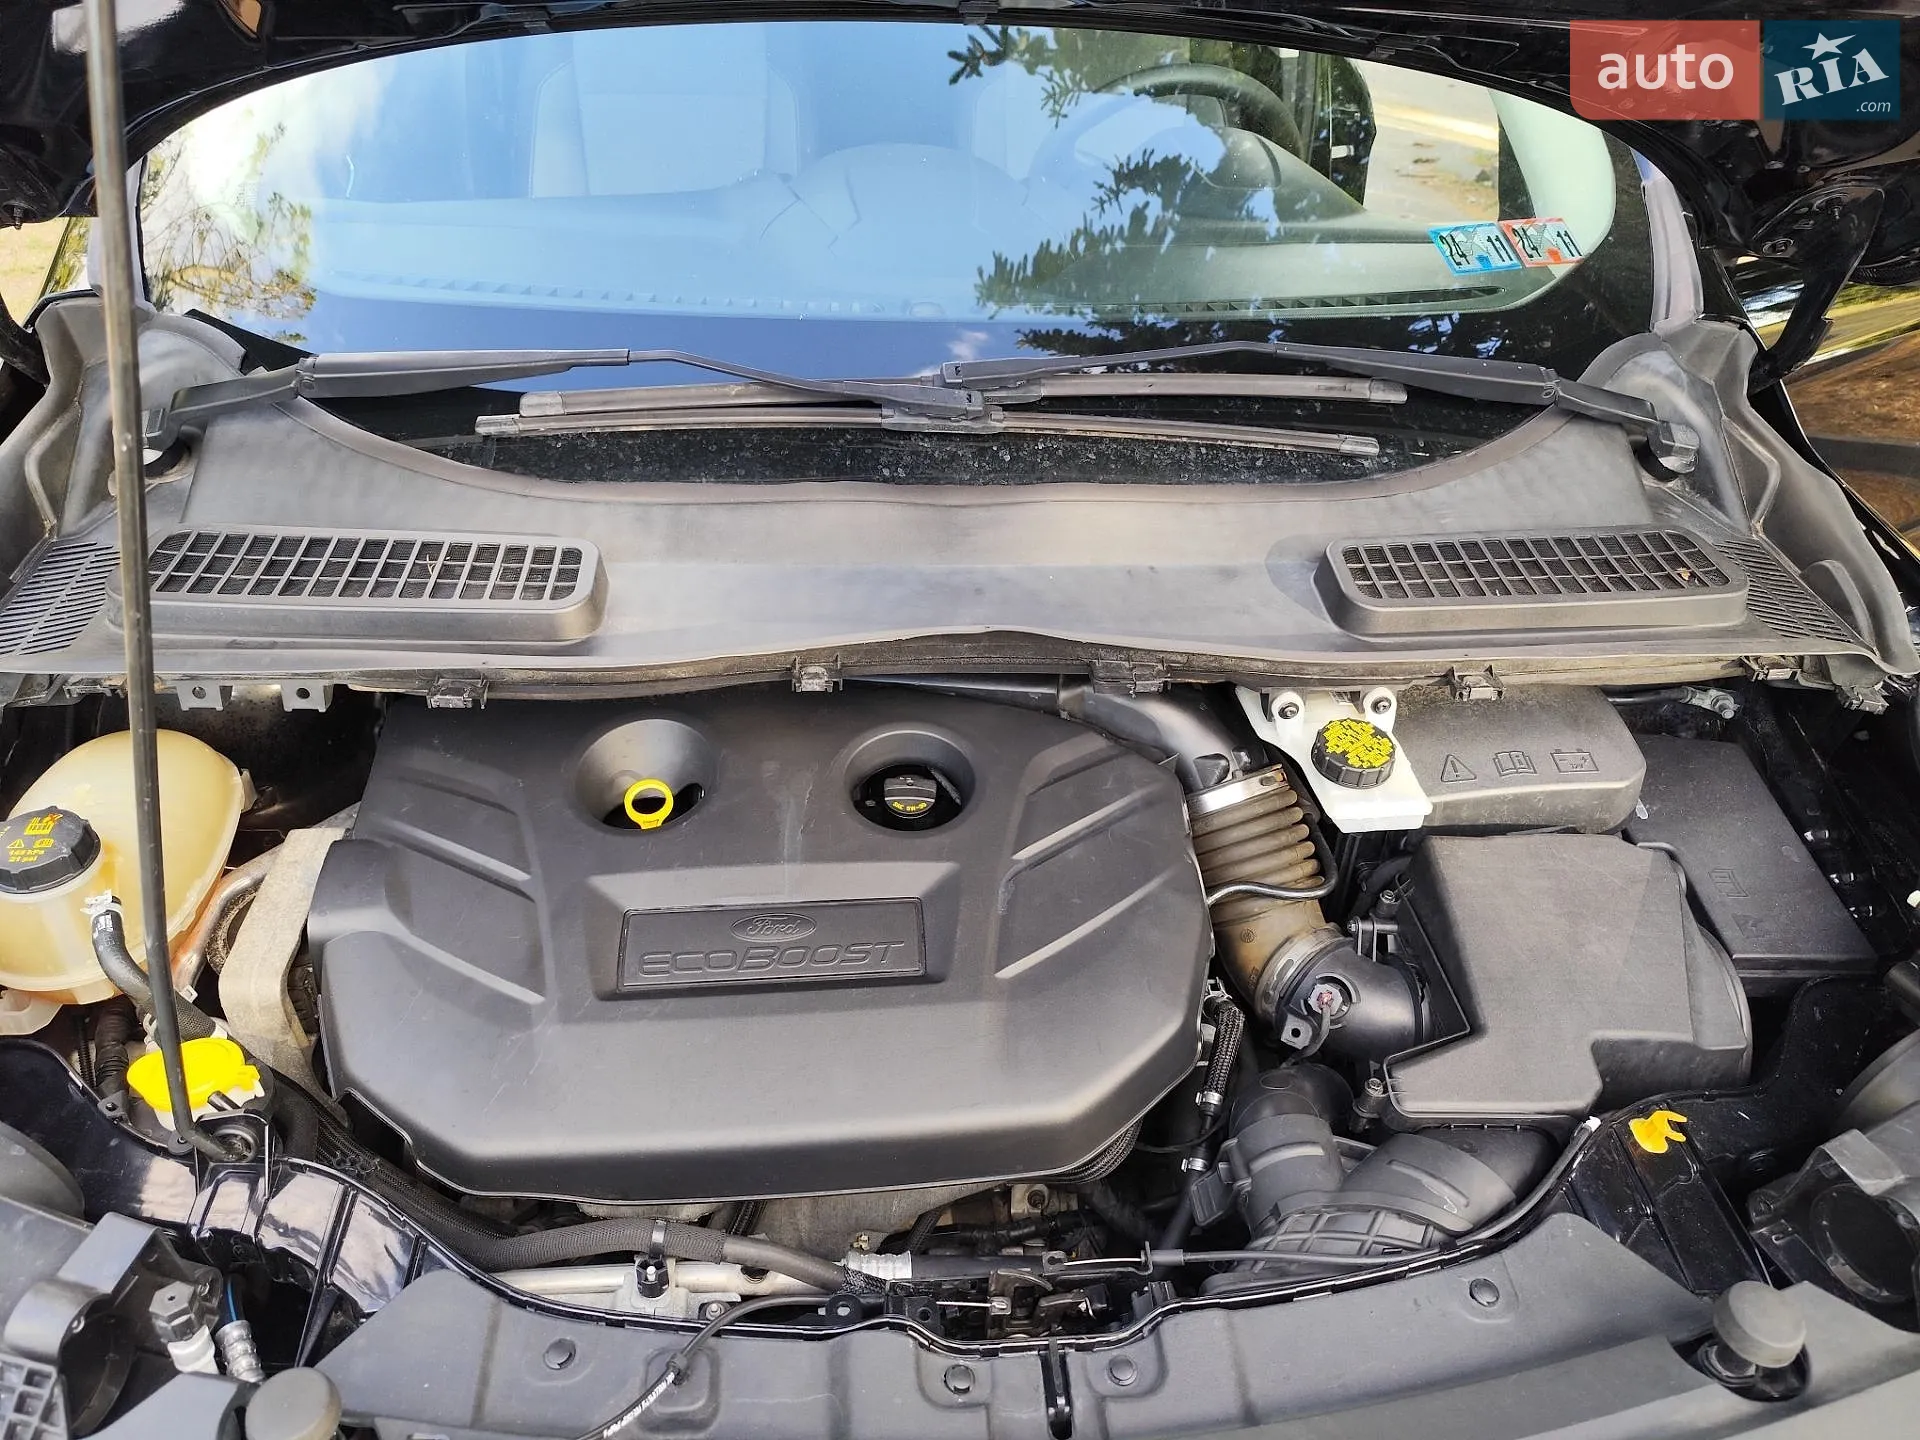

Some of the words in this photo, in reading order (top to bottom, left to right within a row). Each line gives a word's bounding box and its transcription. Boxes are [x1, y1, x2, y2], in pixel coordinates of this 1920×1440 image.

[1439, 234, 1471, 266] 24
[1486, 234, 1513, 263] 11
[1511, 226, 1542, 259] 24
[1556, 229, 1582, 257] 11
[746, 916, 801, 937] Ford
